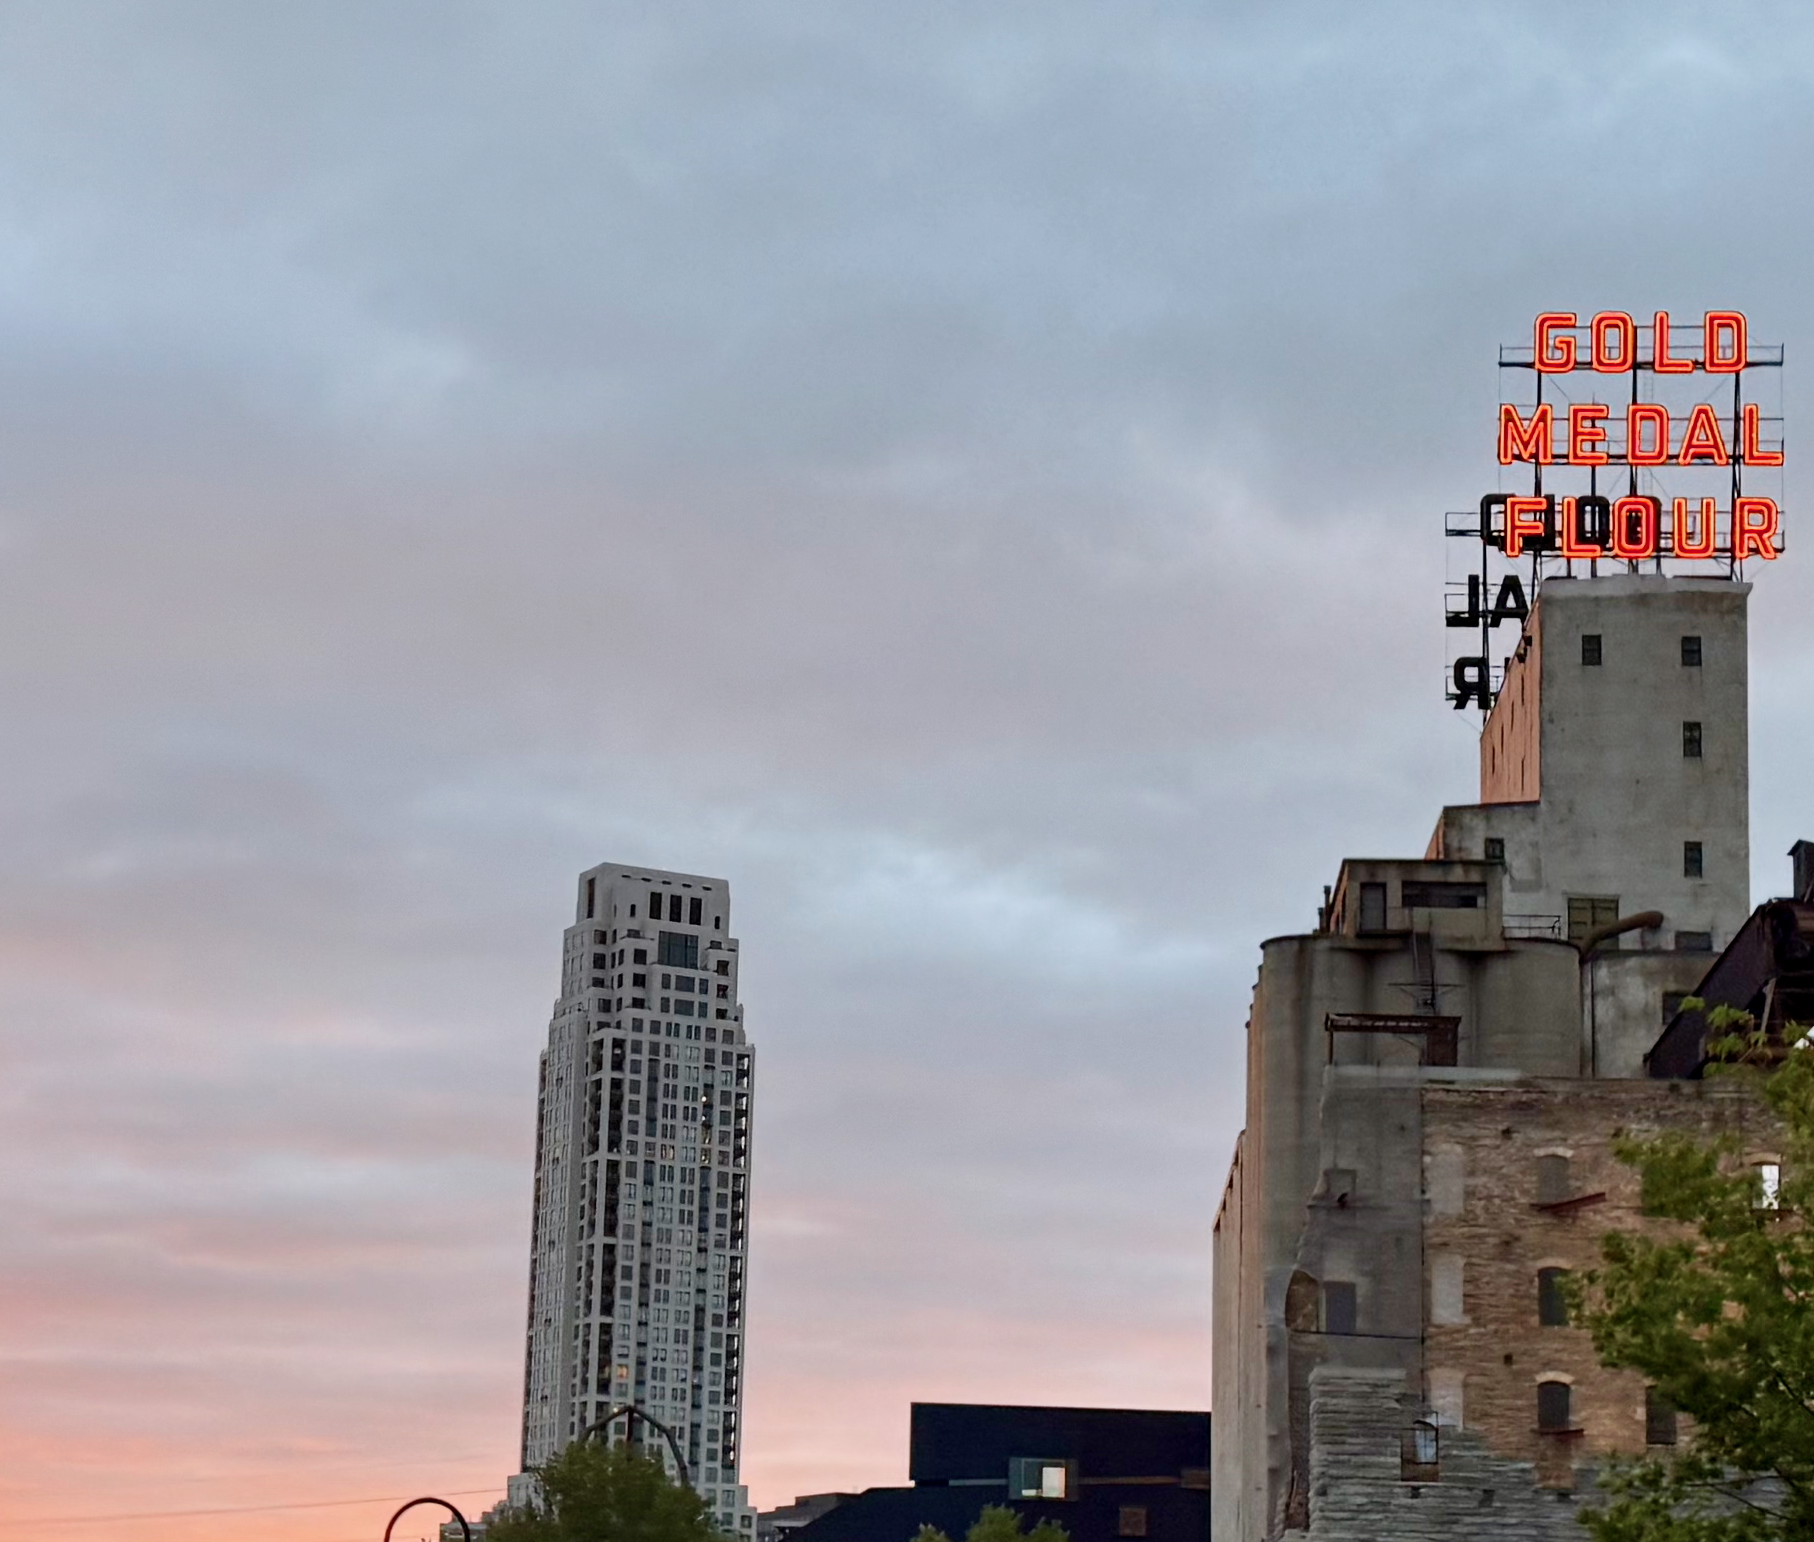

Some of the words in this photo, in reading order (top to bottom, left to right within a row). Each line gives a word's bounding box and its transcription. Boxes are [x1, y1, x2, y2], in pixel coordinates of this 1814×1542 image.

[1534, 310, 1747, 374] GOLD
[1497, 403, 1785, 466] MEDAL
[1504, 496, 1779, 560] FLOUR
